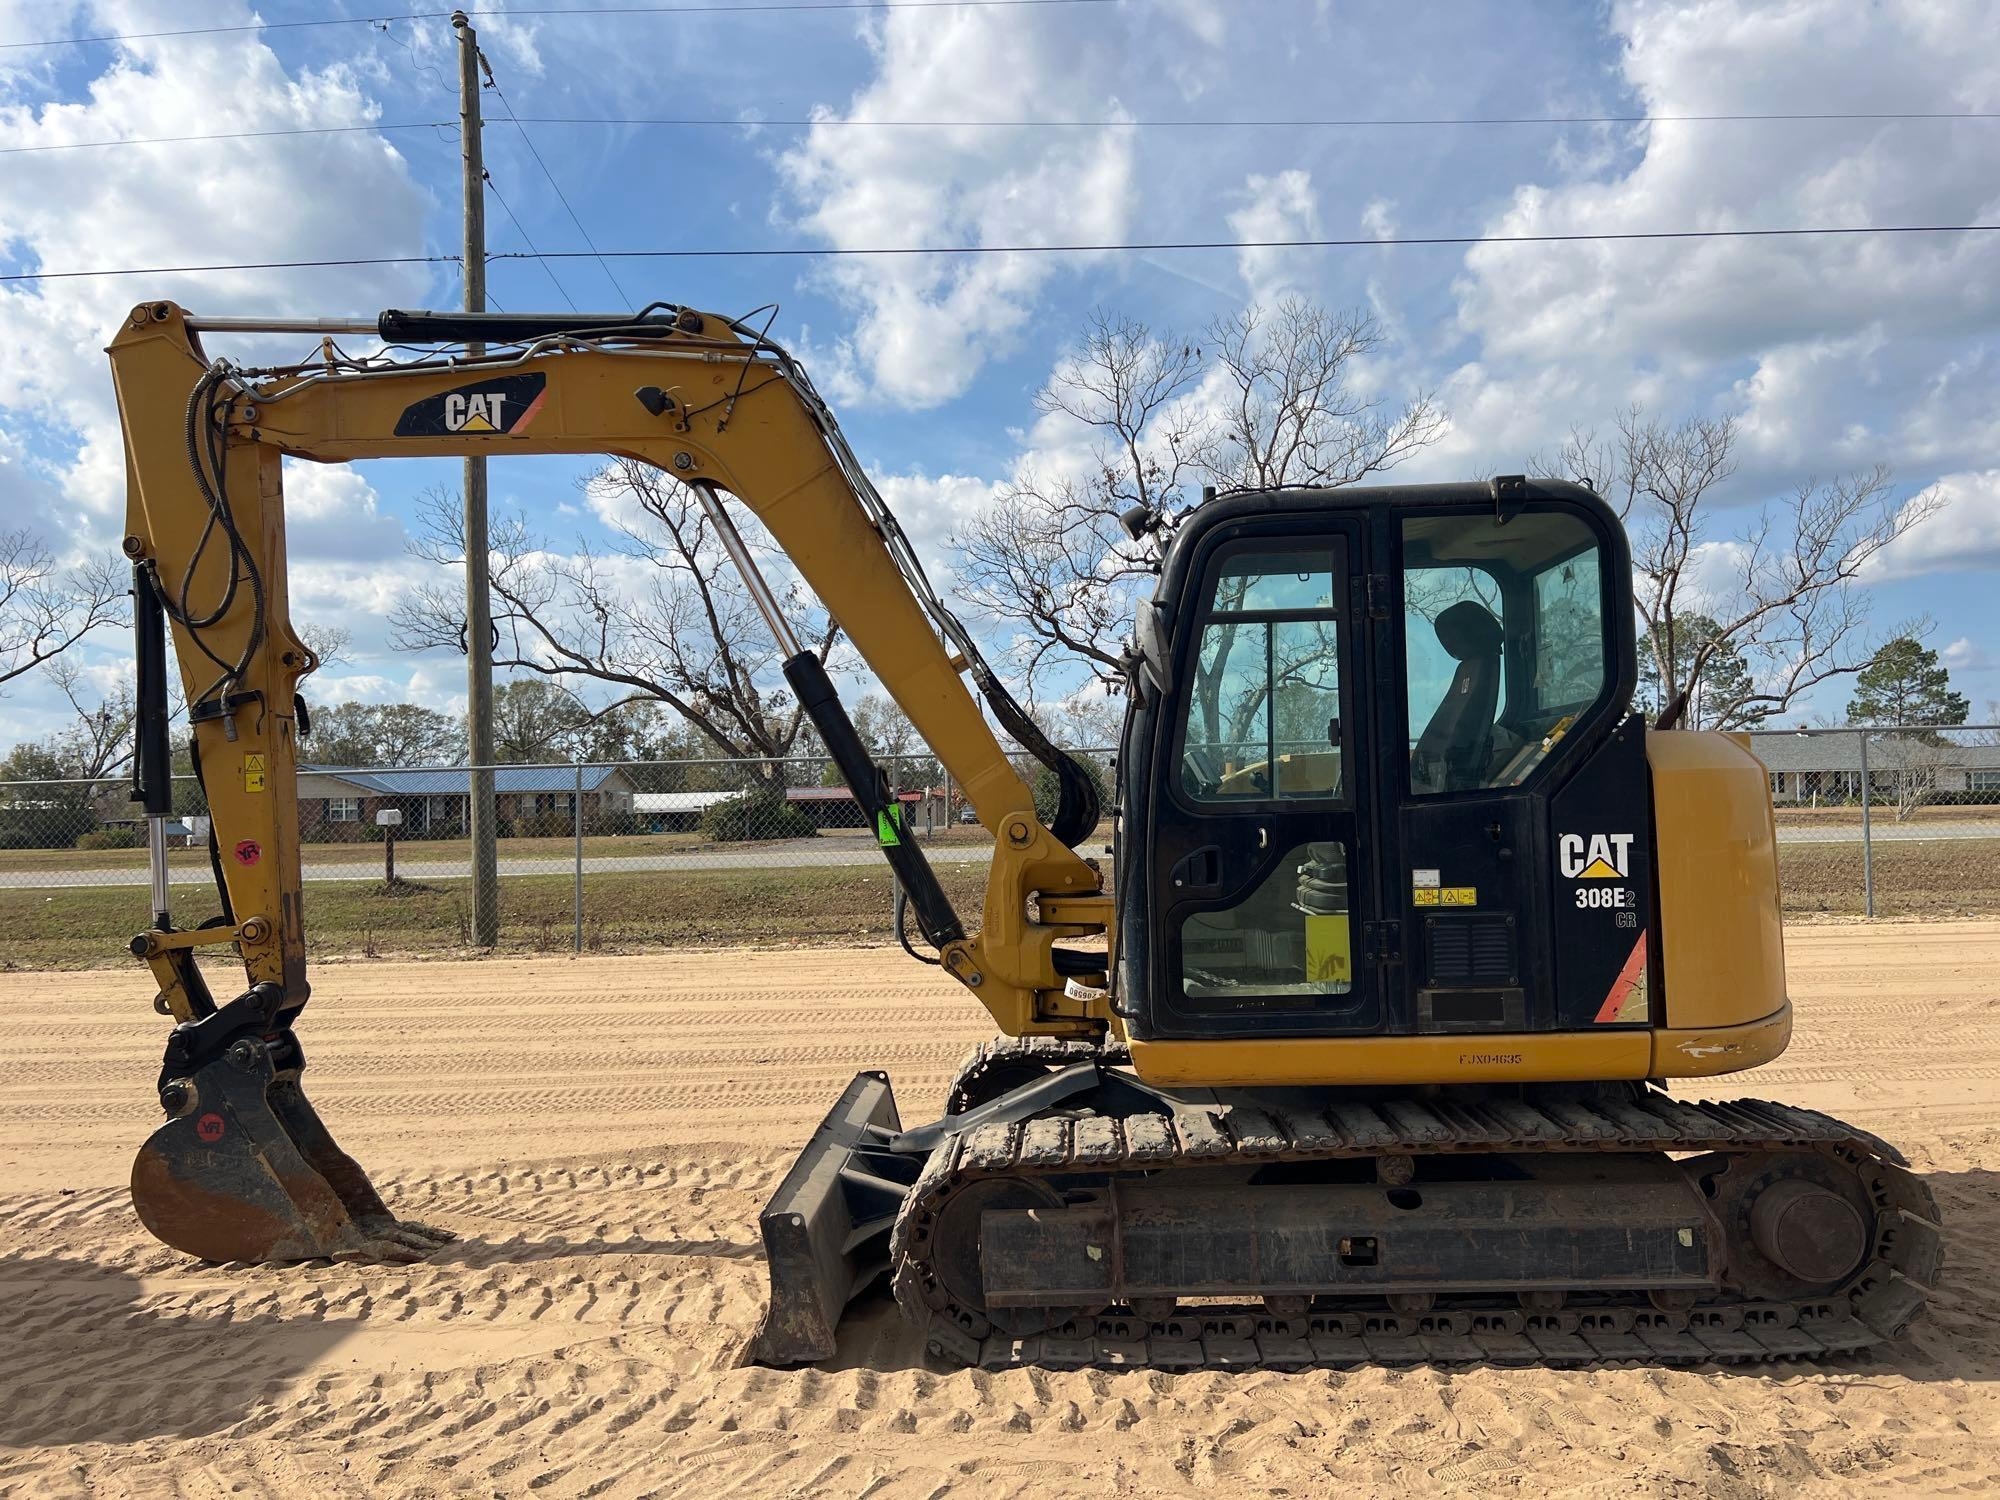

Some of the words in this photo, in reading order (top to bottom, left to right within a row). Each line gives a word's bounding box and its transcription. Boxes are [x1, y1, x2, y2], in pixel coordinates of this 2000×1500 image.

[445, 393, 506, 431] CAT
[1559, 833, 1634, 878] CAT
[1575, 887, 1636, 908] 308E2
[1615, 912, 1637, 928] CR
[1459, 1054, 1523, 1064] FJX04635
